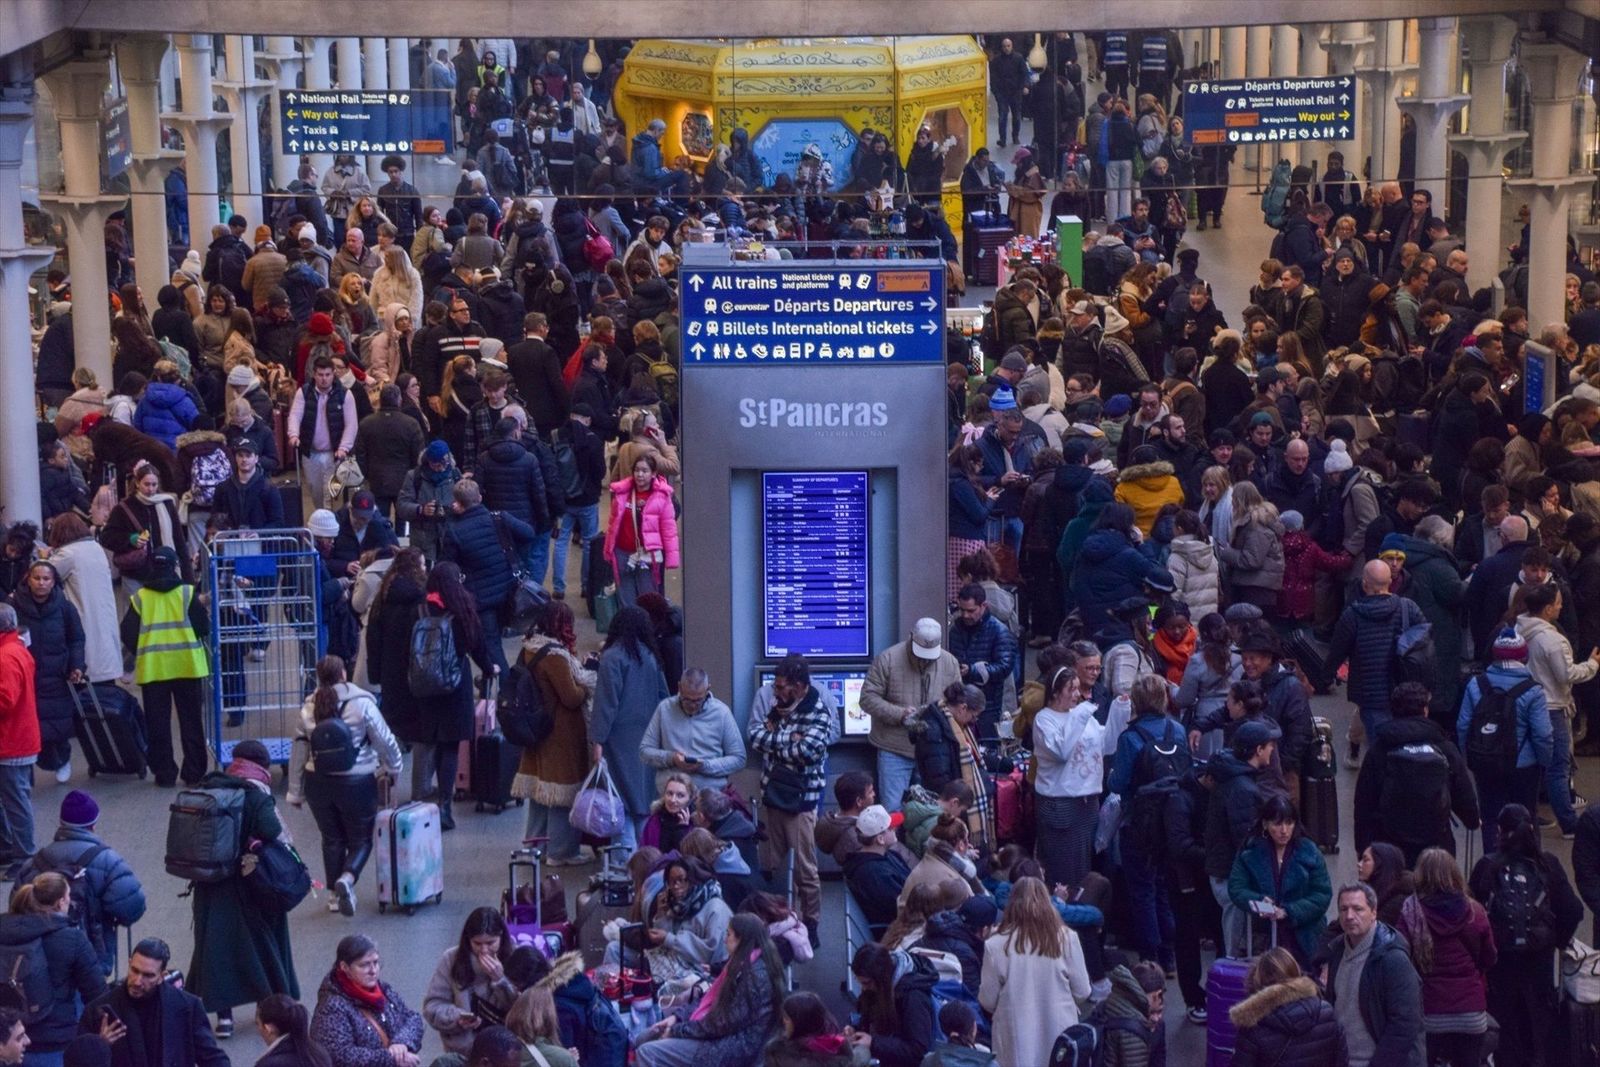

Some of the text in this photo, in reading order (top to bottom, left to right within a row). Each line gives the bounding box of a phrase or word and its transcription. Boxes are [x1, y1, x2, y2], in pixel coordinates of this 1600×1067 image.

[1245, 81, 1281, 93] Départs
[1283, 79, 1336, 91] Departures
[300, 94, 360, 104] National Rail
[1276, 95, 1335, 107] National Rail
[302, 110, 339, 121] Way out
[1298, 112, 1318, 123] Way
[1320, 112, 1335, 121] out
[302, 126, 327, 135] Taxis
[1280, 129, 1287, 139] P
[351, 141, 358, 151] P
[712, 275, 778, 289] All trains
[782, 273, 835, 281] National tickets
[796, 282, 829, 291] platforms
[734, 298, 914, 316] eurostar Départs Departures
[722, 320, 915, 336] Billets International tickets
[804, 343, 815, 359] P
[770, 398, 888, 428] Pancras
